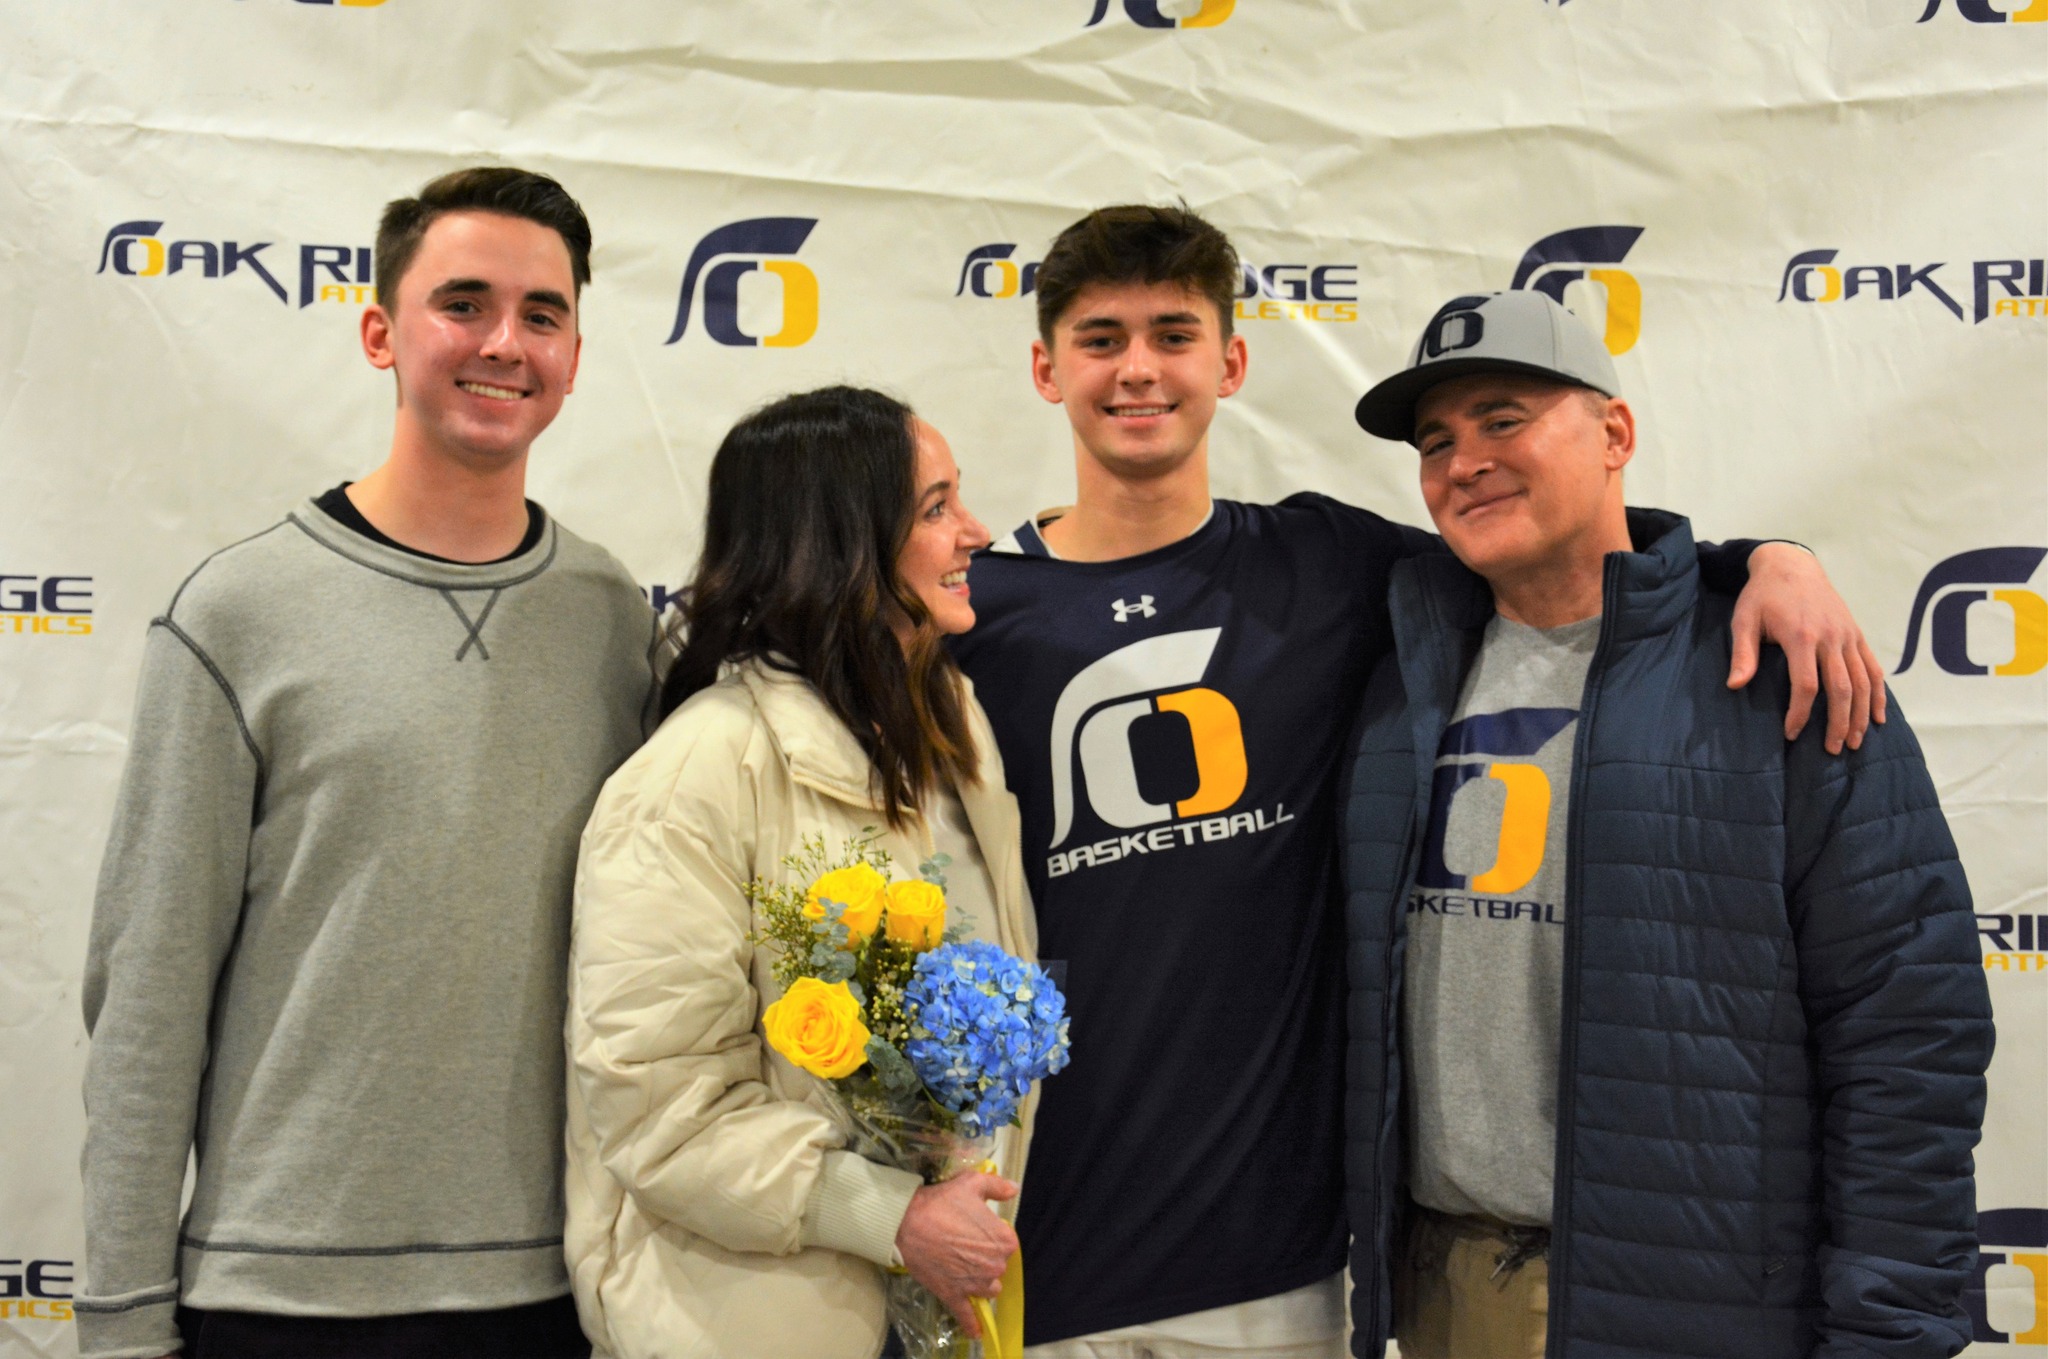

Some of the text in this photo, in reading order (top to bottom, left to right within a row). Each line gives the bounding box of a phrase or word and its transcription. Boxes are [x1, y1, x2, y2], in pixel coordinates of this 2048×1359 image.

[96, 221, 372, 309] OAK RI
[1233, 265, 1358, 301] DGE
[320, 285, 378, 304] AT
[1777, 249, 2048, 325] OAK RI
[1235, 301, 1358, 322] LETICS
[1995, 298, 2048, 316] AT
[1047, 803, 1295, 878] BASKETBALL
